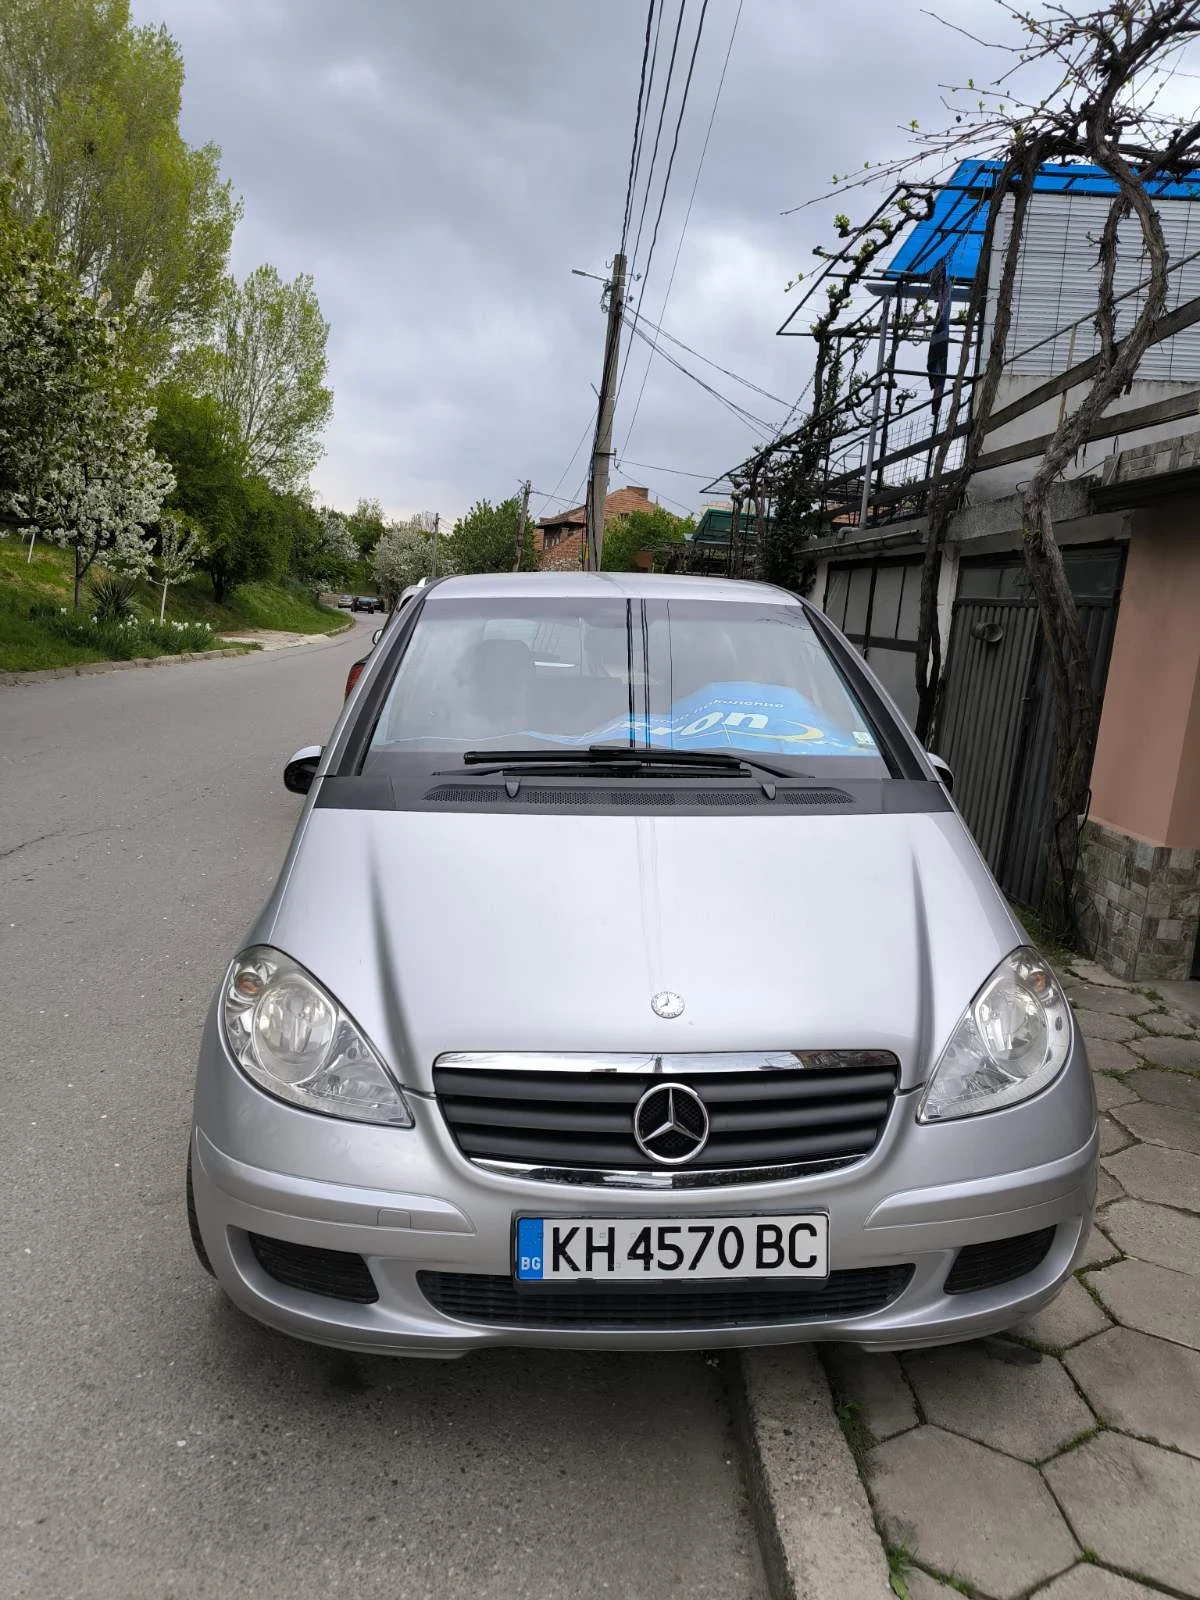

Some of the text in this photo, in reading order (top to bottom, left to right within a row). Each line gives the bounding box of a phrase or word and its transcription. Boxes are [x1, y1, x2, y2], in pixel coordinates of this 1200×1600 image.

[521, 1256, 541, 1270] BG
[552, 1223, 818, 1272] KH 4570 BC
